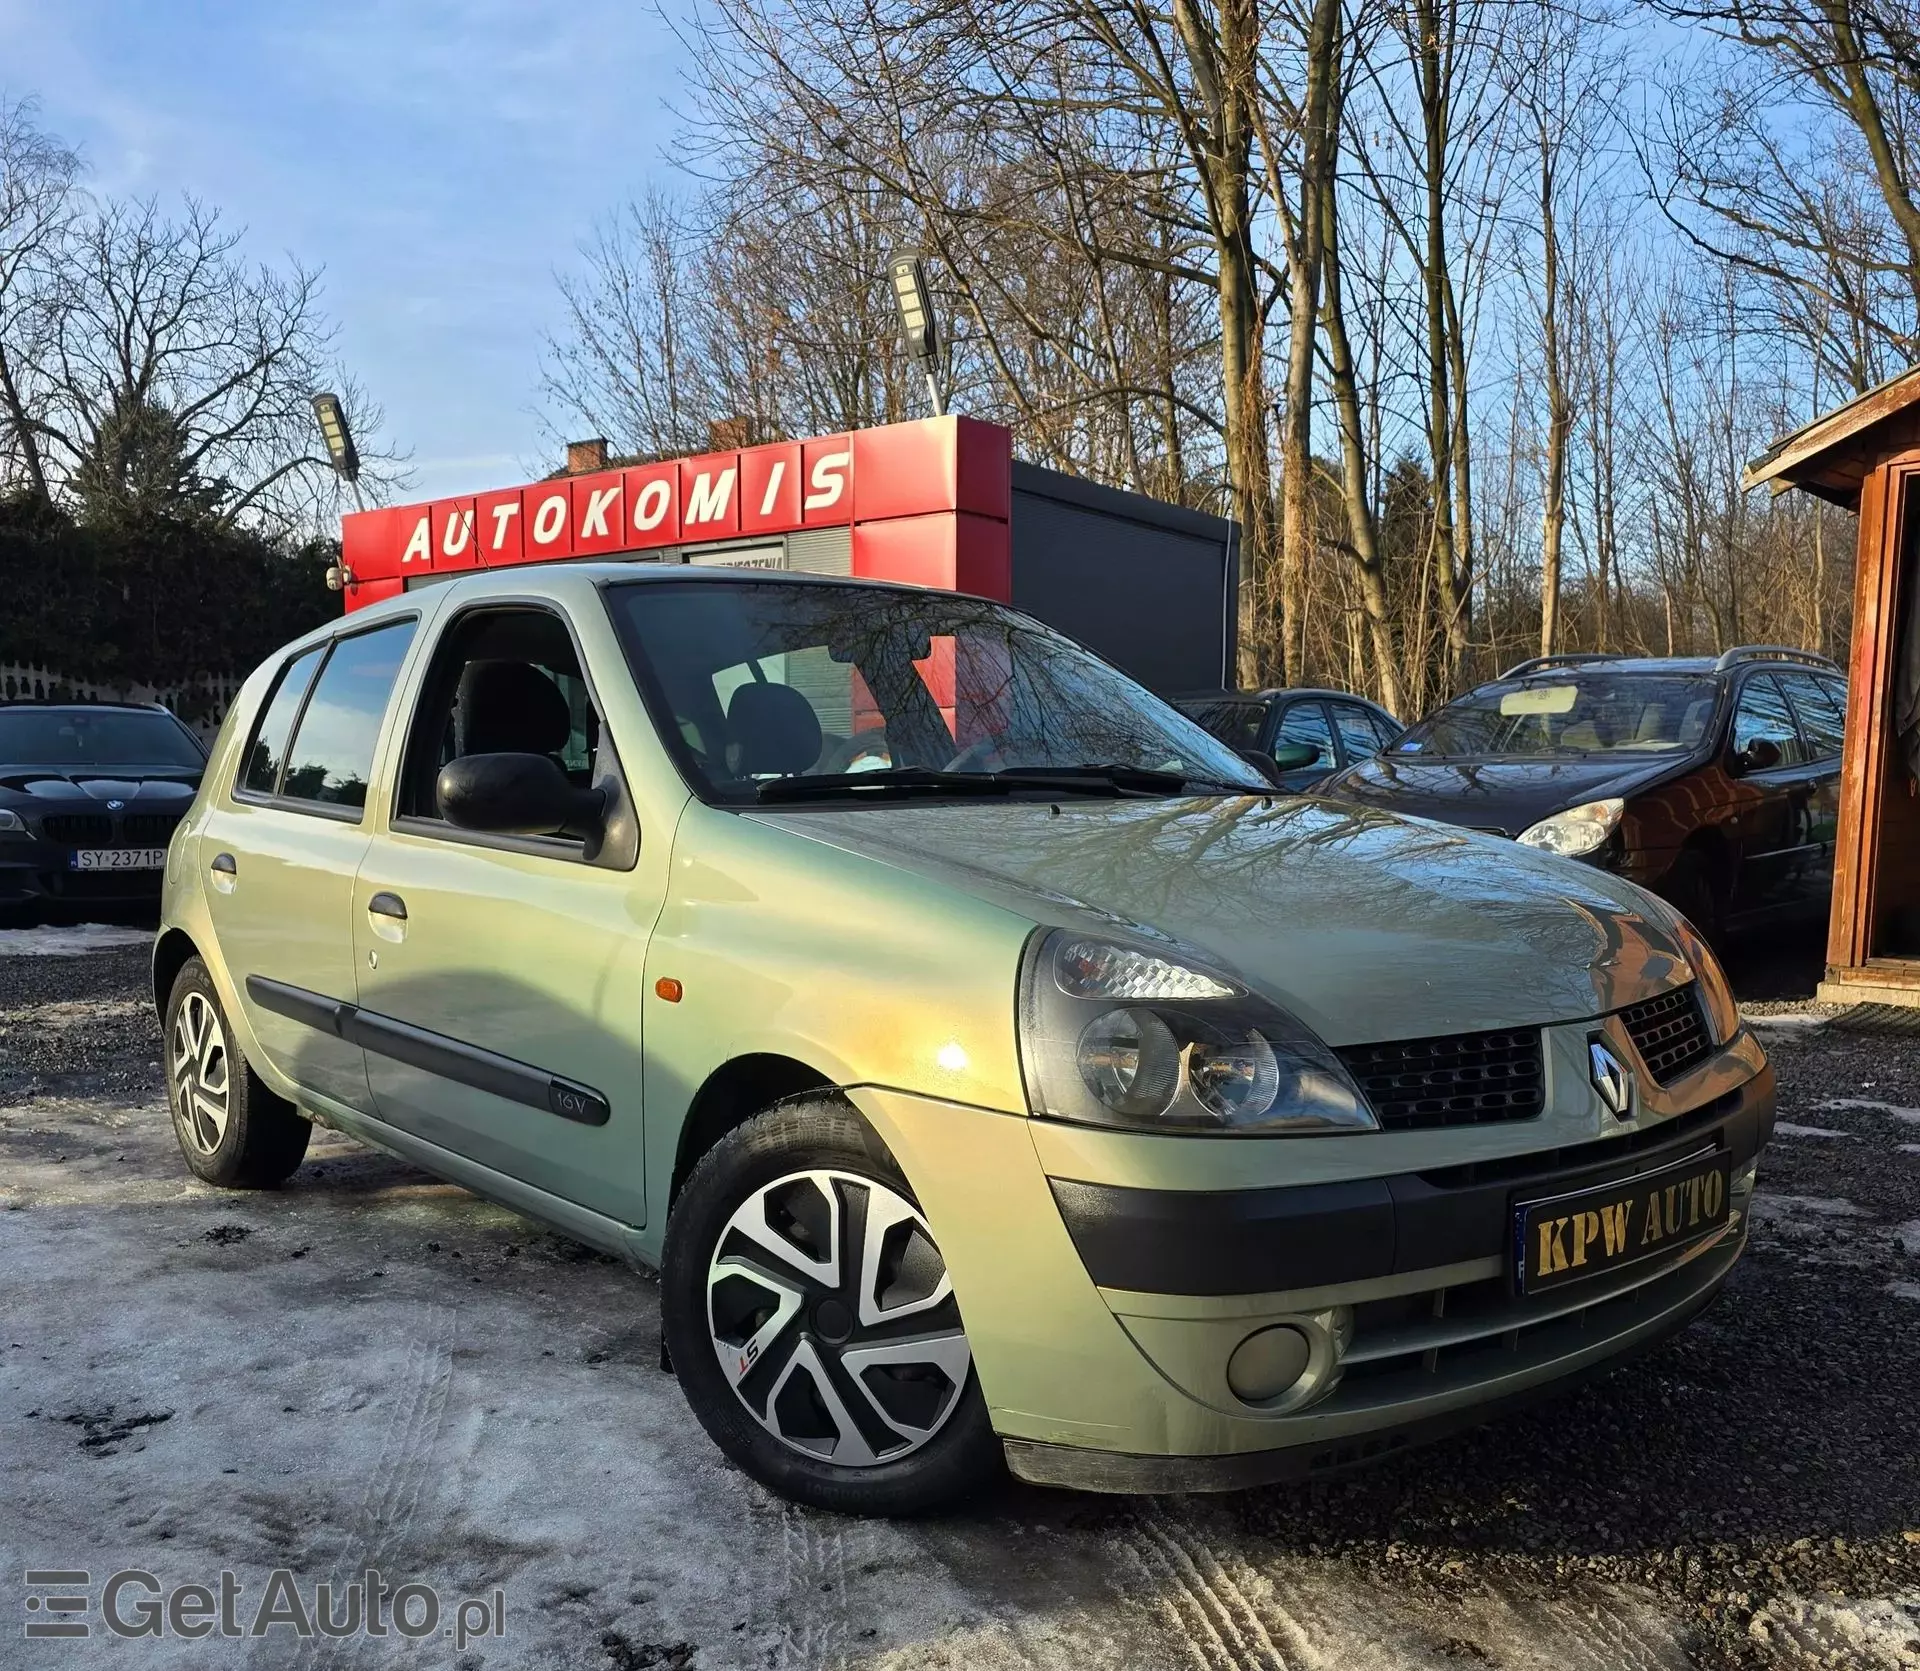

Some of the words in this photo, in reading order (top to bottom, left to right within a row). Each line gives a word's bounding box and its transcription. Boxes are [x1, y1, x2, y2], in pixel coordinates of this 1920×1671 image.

[402, 451, 849, 563] AUTOKOMIS
[81, 852, 103, 867] SY
[112, 851, 162, 866] 2371P
[557, 1092, 586, 1114] 16V
[1537, 1200, 1633, 1276] KPW
[1641, 1169, 1723, 1245] AUTO
